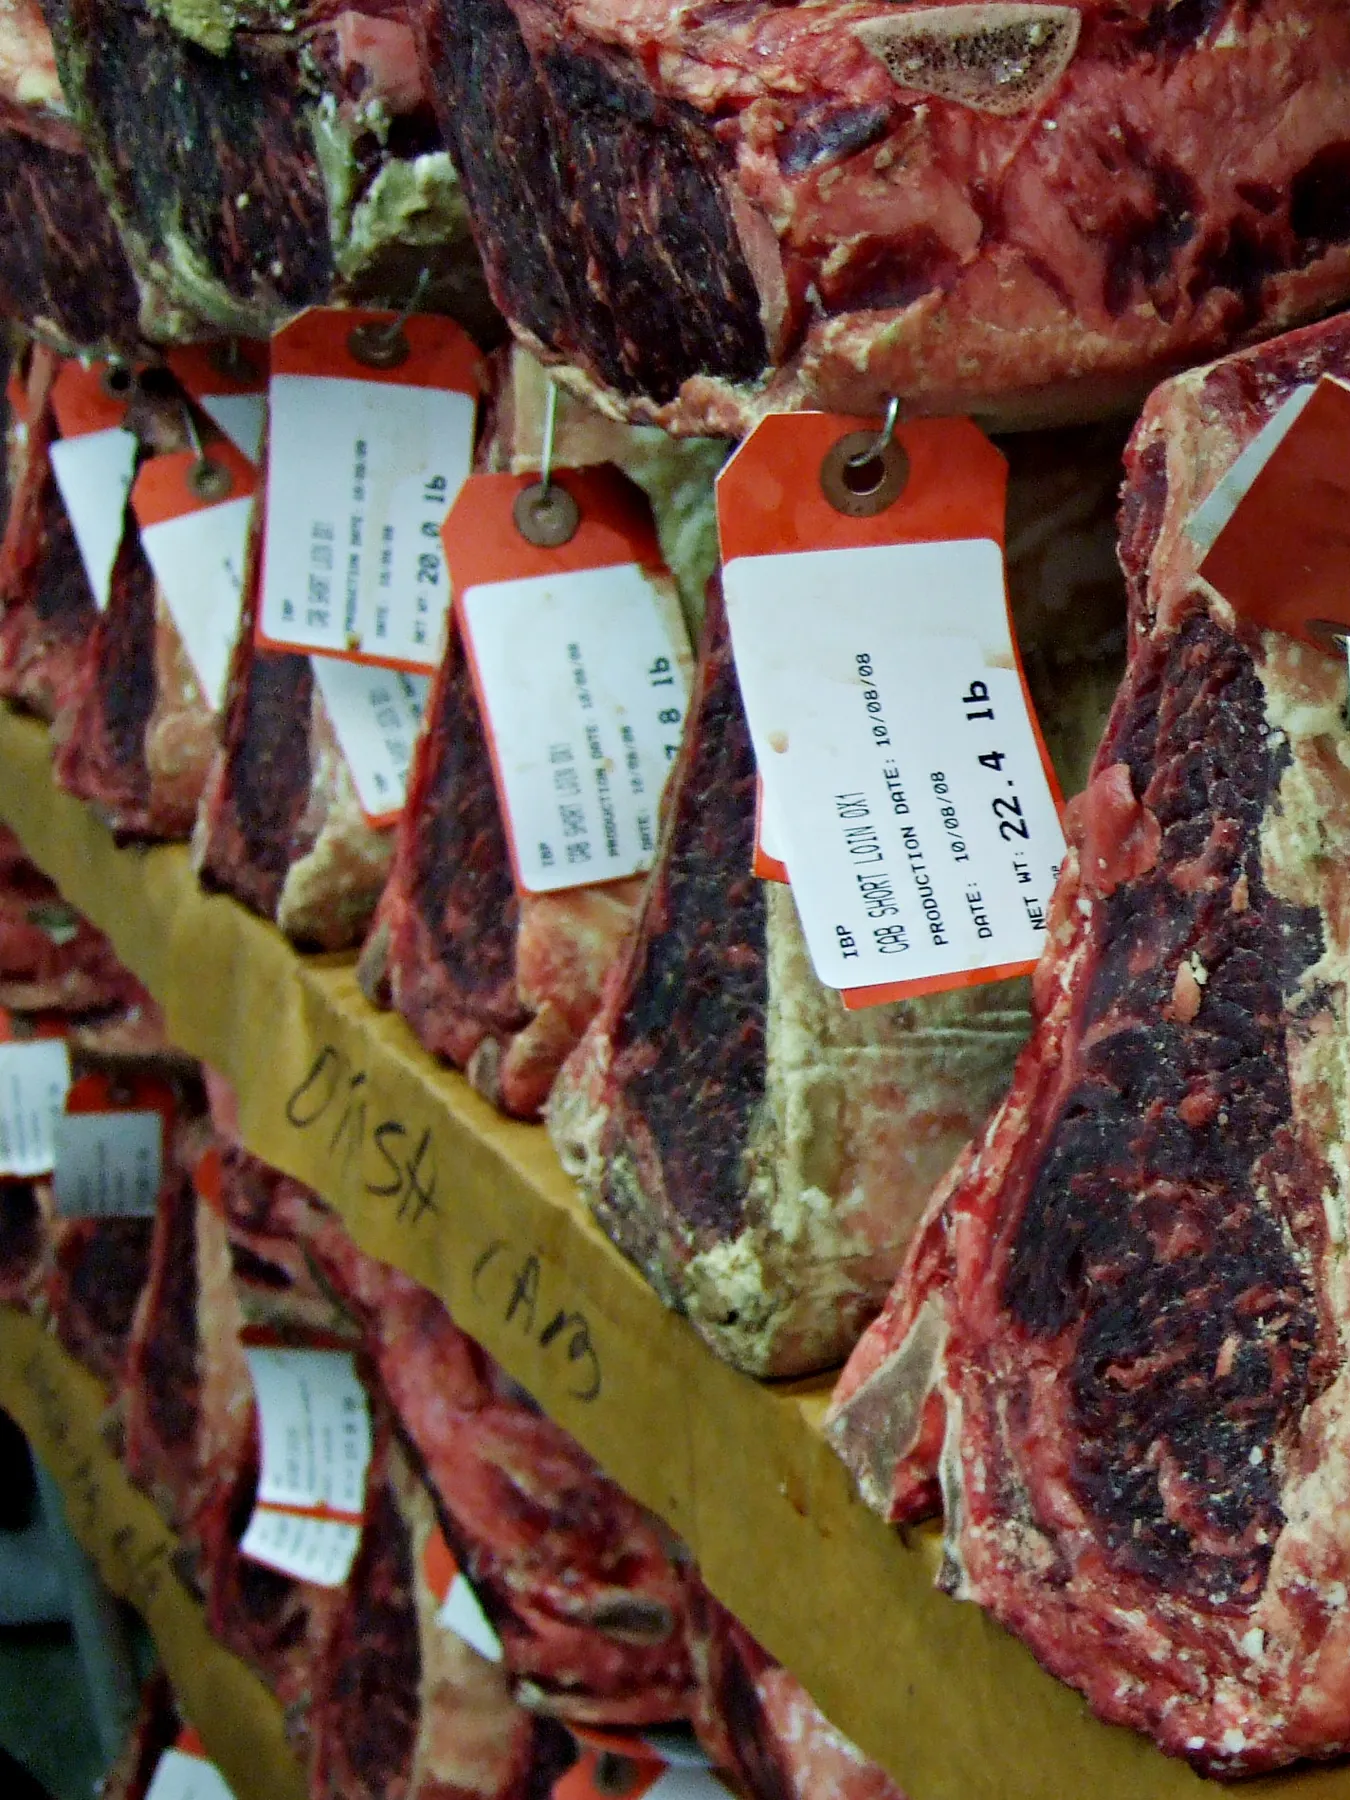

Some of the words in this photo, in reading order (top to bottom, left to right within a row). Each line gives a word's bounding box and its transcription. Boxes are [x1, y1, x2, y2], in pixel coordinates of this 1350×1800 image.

[649, 657, 675, 687] lb
[855, 653, 891, 747] 10/08/08
[962, 679, 995, 721] lb
[883, 758, 910, 815] DATE:
[978, 750, 1030, 842] 22.4
[595, 767, 620, 857] PRODUCTION
[930, 771, 970, 863] 10/08/08
[843, 825, 883, 865] LOIN
[1013, 851, 1032, 884] WT:
[856, 872, 899, 918] SHORT
[900, 826, 949, 946] PRODUCTION
[966, 882, 993, 939] DATE:
[1023, 896, 1047, 931] NET
[835, 924, 860, 959] IBP
[873, 923, 909, 955] CAB
